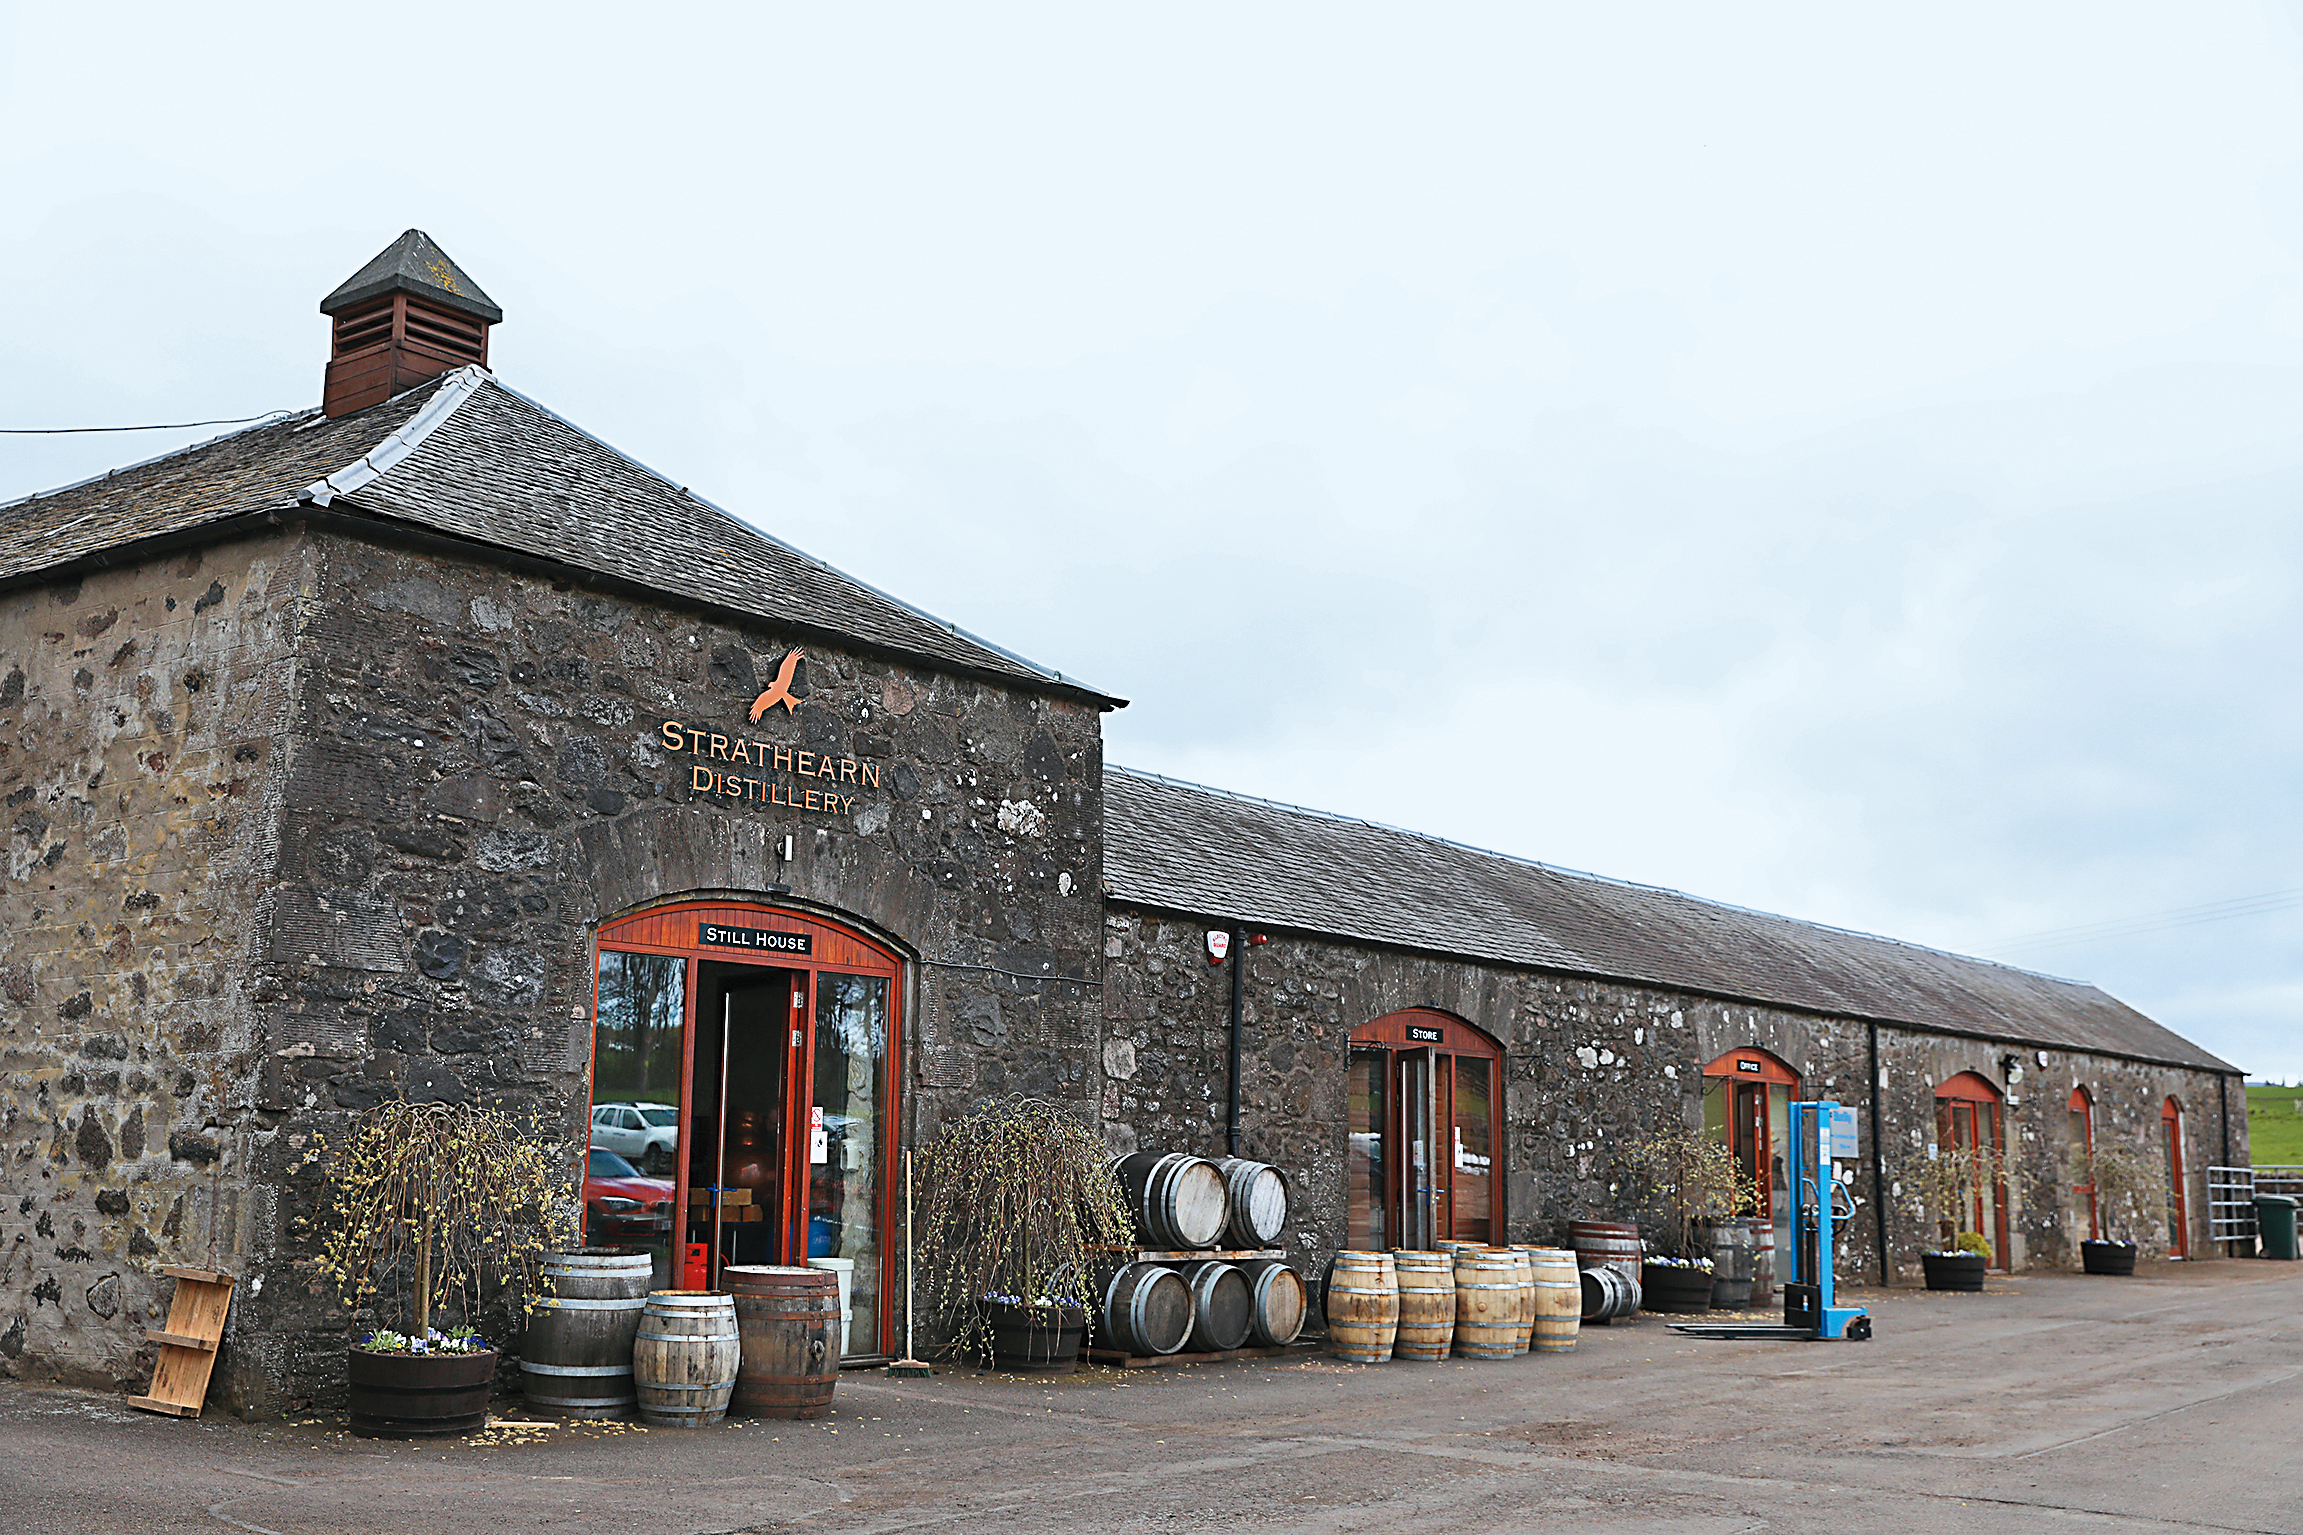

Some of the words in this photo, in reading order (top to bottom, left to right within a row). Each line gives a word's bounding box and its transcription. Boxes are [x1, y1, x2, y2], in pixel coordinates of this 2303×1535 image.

[661, 720, 880, 788] STRATHEARN
[692, 765, 854, 815] DISTILLERY
[706, 927, 750, 945] STILL
[756, 932, 806, 951] HOUSE
[1412, 1028, 1438, 1040] STORE
